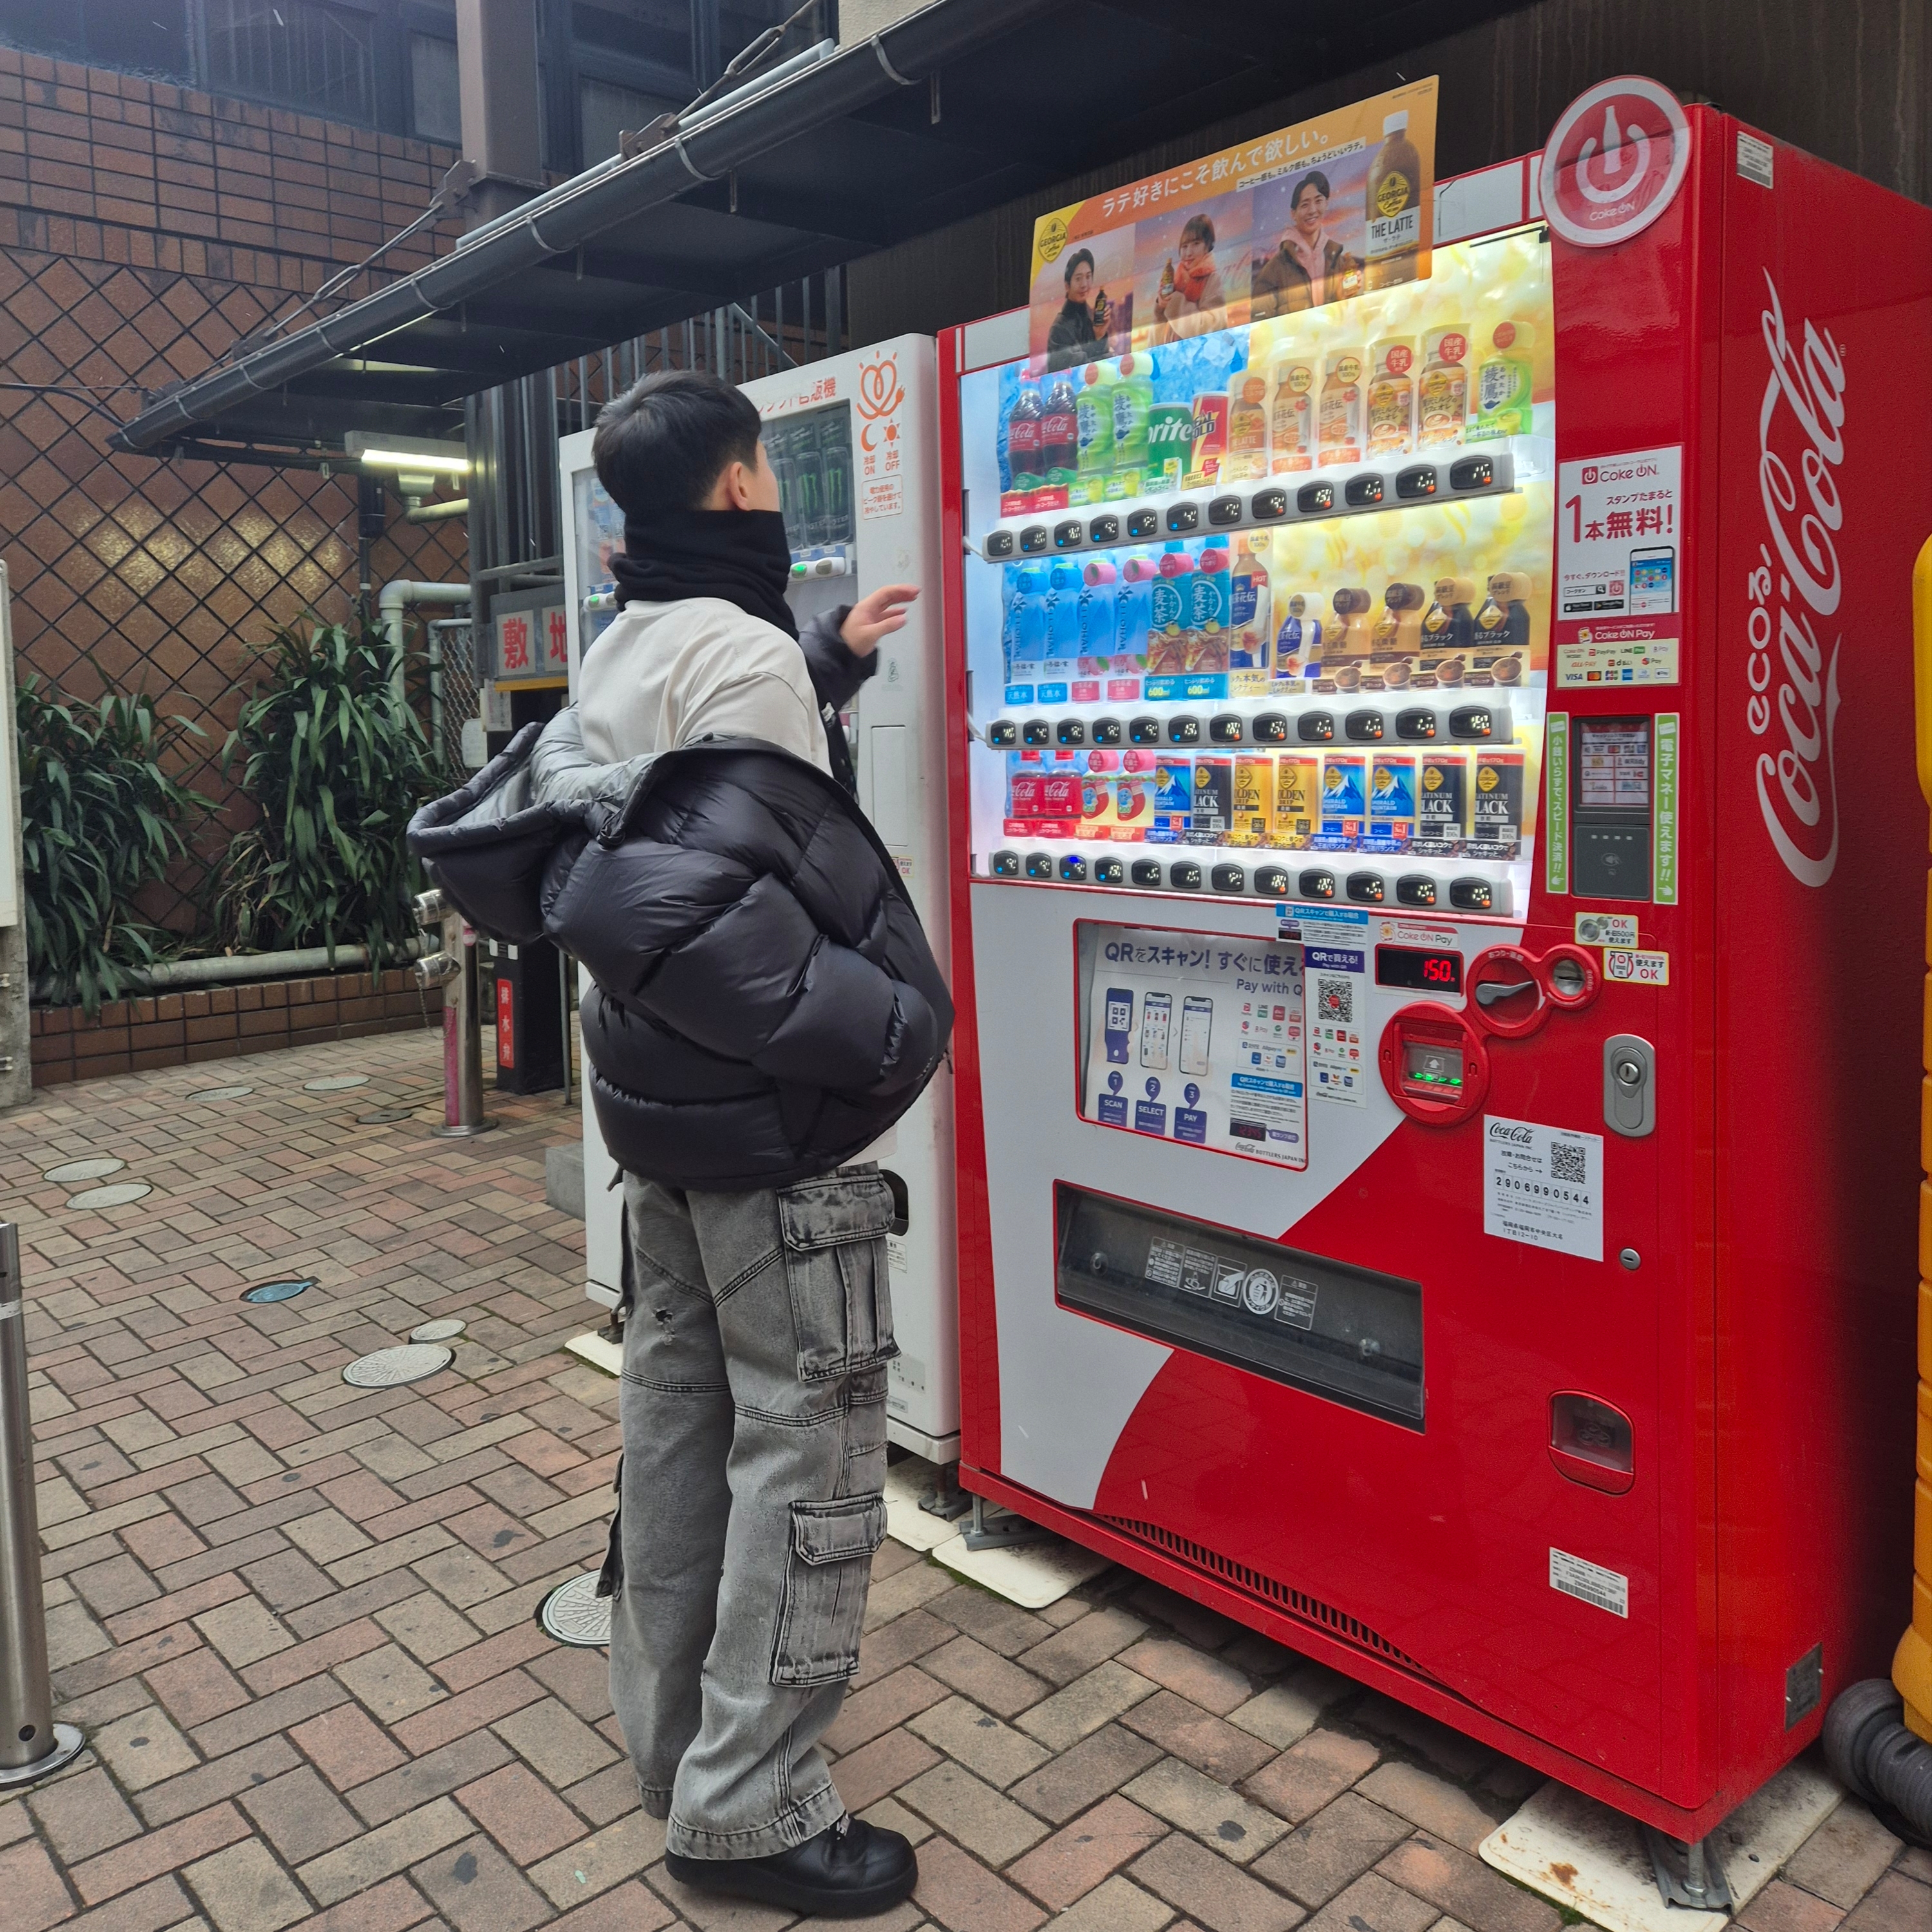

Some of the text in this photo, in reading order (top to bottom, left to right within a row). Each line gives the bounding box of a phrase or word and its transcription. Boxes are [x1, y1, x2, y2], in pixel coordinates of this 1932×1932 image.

[1103, 131, 1329, 218] ラテ好きにこそ飲んで欲しい。
[1378, 187, 1408, 202] GEORGIA
[1589, 208, 1617, 221] Coke
[1371, 214, 1414, 239] THE LATTE
[1040, 232, 1067, 247] GEORGIA
[1148, 416, 1193, 444] rite
[864, 466, 876, 475] ON
[885, 460, 900, 471] OFF
[1600, 464, 1658, 482] Coke ON
[1606, 489, 1673, 505] スタンプたまると
[1565, 495, 1673, 544] 1本無料!
[1253, 574, 1267, 583] HOT
[1756, 265, 1847, 887] Coca-Cola
[1153, 588, 1169, 623] 麦茶
[1193, 585, 1208, 621] 麦茶
[1595, 629, 1656, 639] Coke ON Pay
[1195, 795, 1219, 808] LACK
[1421, 799, 1455, 813] LACK
[1475, 800, 1510, 815] LACK
[1660, 739, 1674, 882] 電子マネー使えます!!
[1612, 919, 1628, 929] OK
[1397, 931, 1419, 941] Coke
[1435, 935, 1453, 945] Pay
[1104, 942, 1305, 977] QRをスキャン! すぐに使え
[1312, 951, 1358, 965] QRで買える!
[1635, 959, 1665, 968] 使えます
[1423, 959, 1452, 982] 150
[1640, 969, 1659, 980] OK
[1236, 979, 1303, 996] Pay with Q
[1104, 1099, 1123, 1108] SCAN
[1138, 1106, 1164, 1116] SELECT
[1183, 1113, 1198, 1122] PAY
[1490, 1122, 1535, 1144] Coca-Cola
[1256, 1150, 1281, 1160] BOTTLERS
[1282, 1153, 1298, 1162] JAPAN
[1508, 1162, 1534, 1173] こちらから
